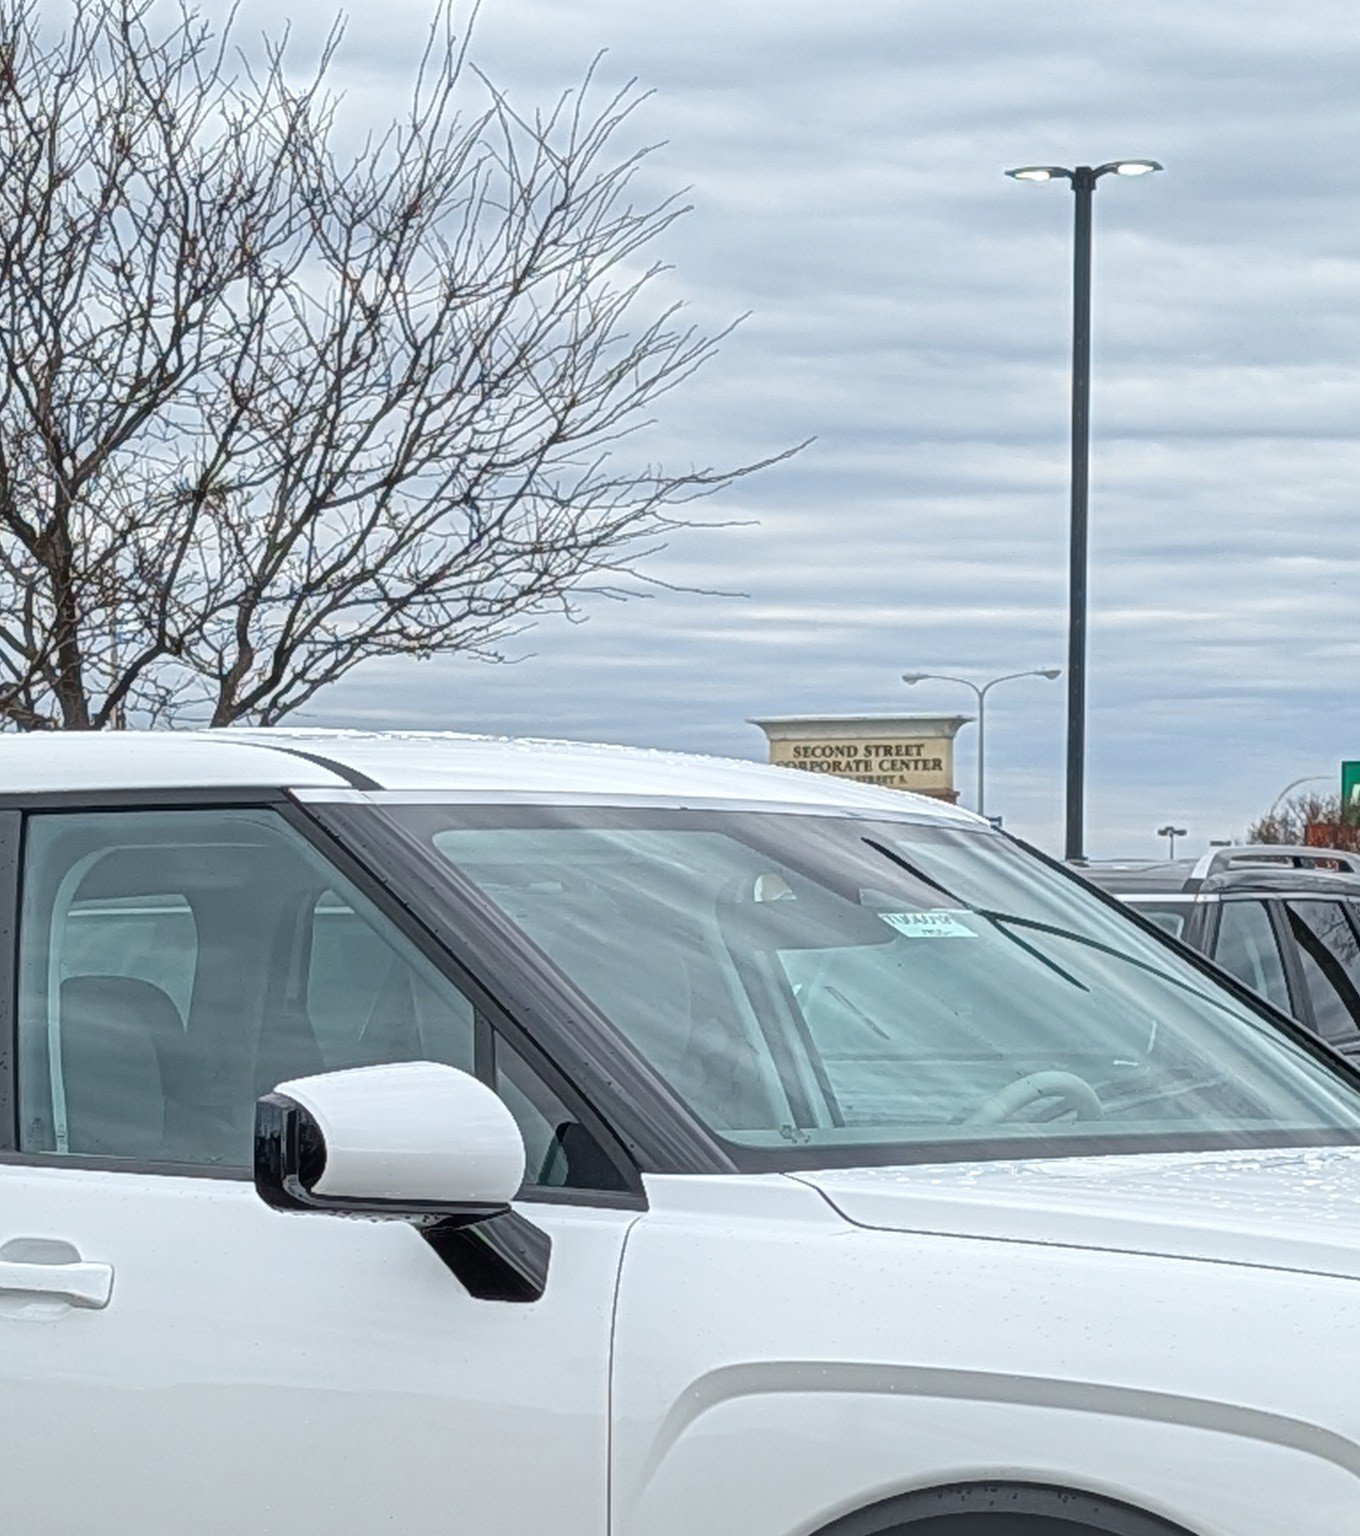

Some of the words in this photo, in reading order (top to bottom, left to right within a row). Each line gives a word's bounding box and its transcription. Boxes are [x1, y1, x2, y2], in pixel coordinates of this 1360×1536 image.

[793, 745, 857, 758] SECOND
[863, 744, 925, 757] STREET
[878, 758, 943, 772] CENTER
